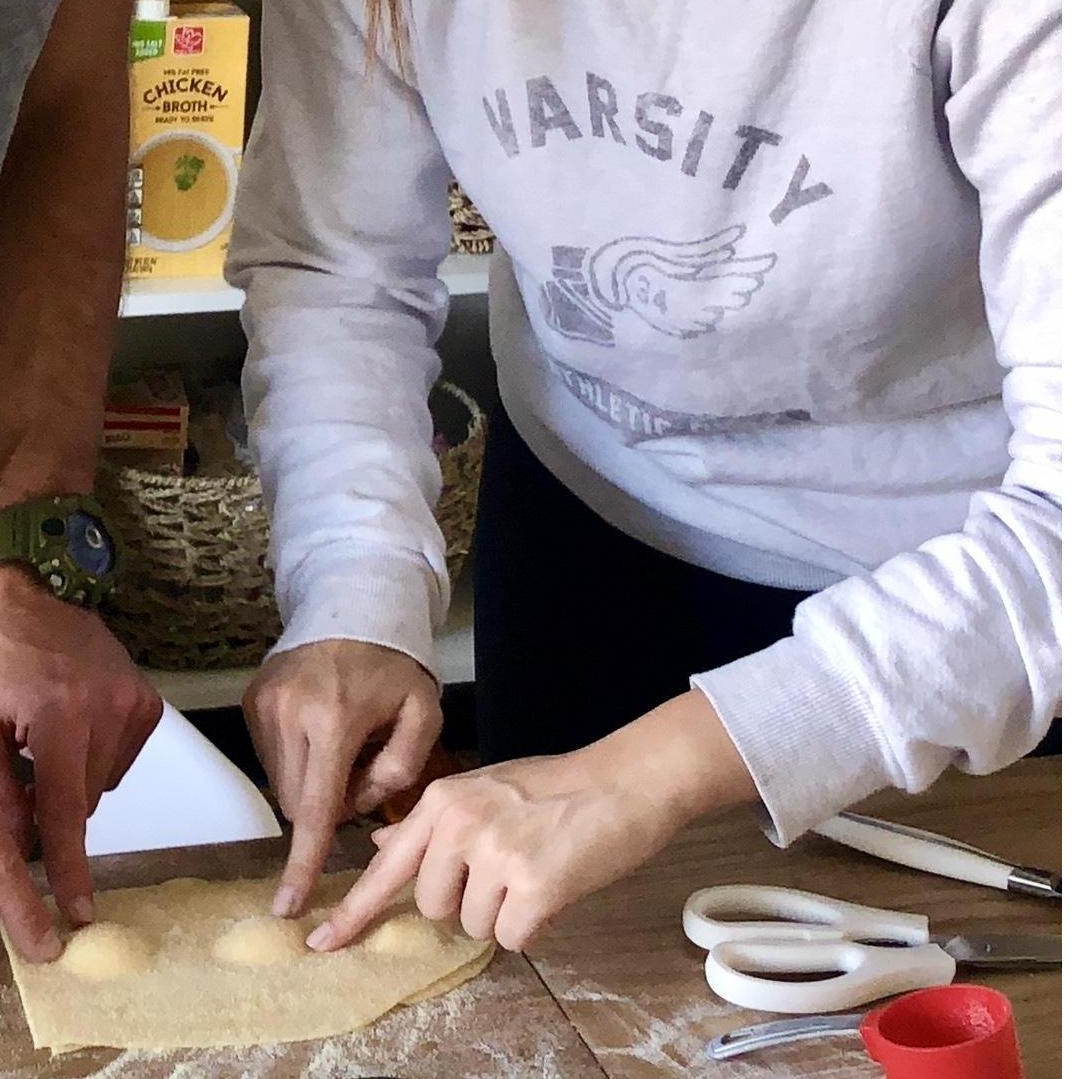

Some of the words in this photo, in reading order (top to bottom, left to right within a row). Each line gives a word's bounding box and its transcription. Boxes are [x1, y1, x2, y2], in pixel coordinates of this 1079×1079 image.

[143, 76, 228, 104] CHICKEN
[162, 100, 208, 113] BROTH
[481, 71, 834, 226] VARSITY
